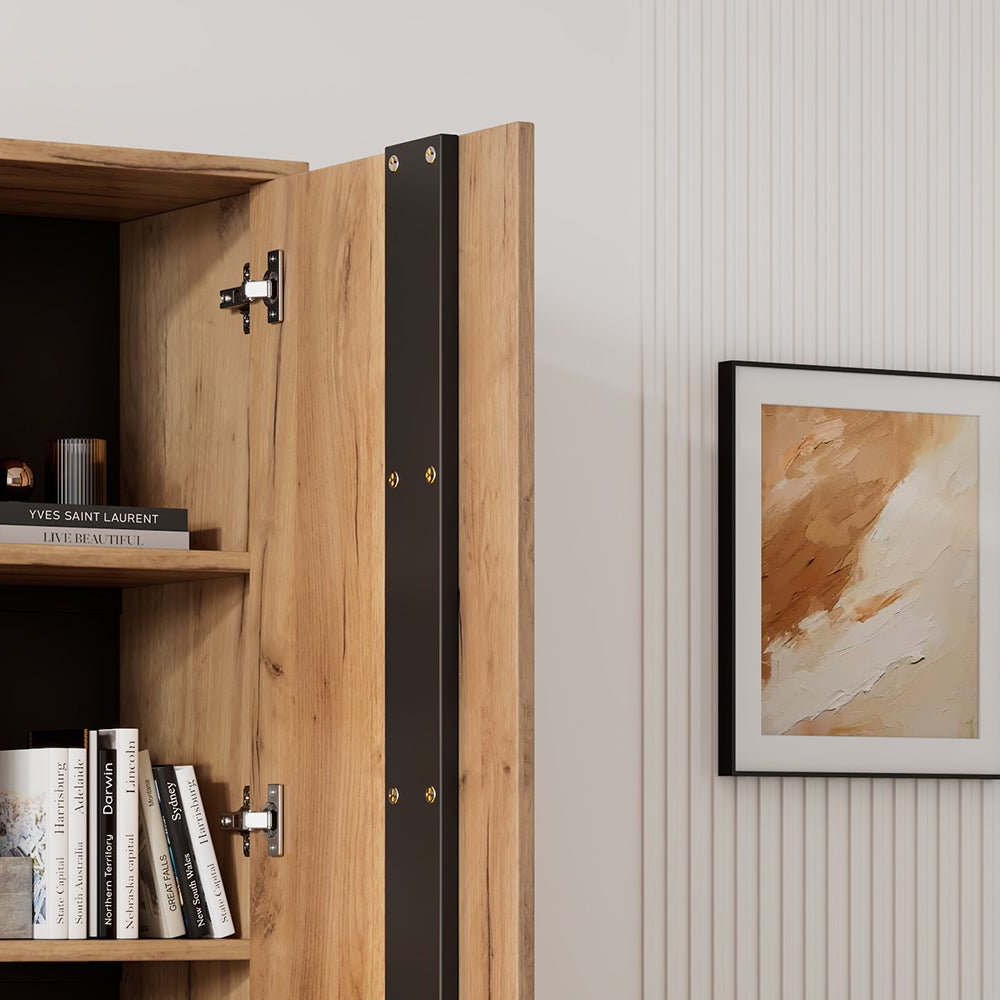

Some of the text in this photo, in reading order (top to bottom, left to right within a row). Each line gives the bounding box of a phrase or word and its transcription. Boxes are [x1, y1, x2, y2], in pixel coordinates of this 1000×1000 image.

[29, 509, 159, 524] YVES SAINT LAURENT
[43, 532, 144, 546] LIVE BEAUTIFUL
[74, 759, 84, 815] Adelaide
[102, 762, 114, 815] Darwin
[125, 740, 136, 793] Lincoln
[54, 762, 67, 834] Harrisburg
[167, 782, 182, 821] Sydney
[187, 779, 209, 845] Harrisburg
[55, 857, 67, 924] State Capital
[74, 842, 83, 925] South Australia
[104, 834, 114, 925] Northern Territory
[125, 834, 137, 929] Nebraska capital
[160, 854, 177, 912] GREAT FALLS
[184, 852, 206, 928] New South Wales
